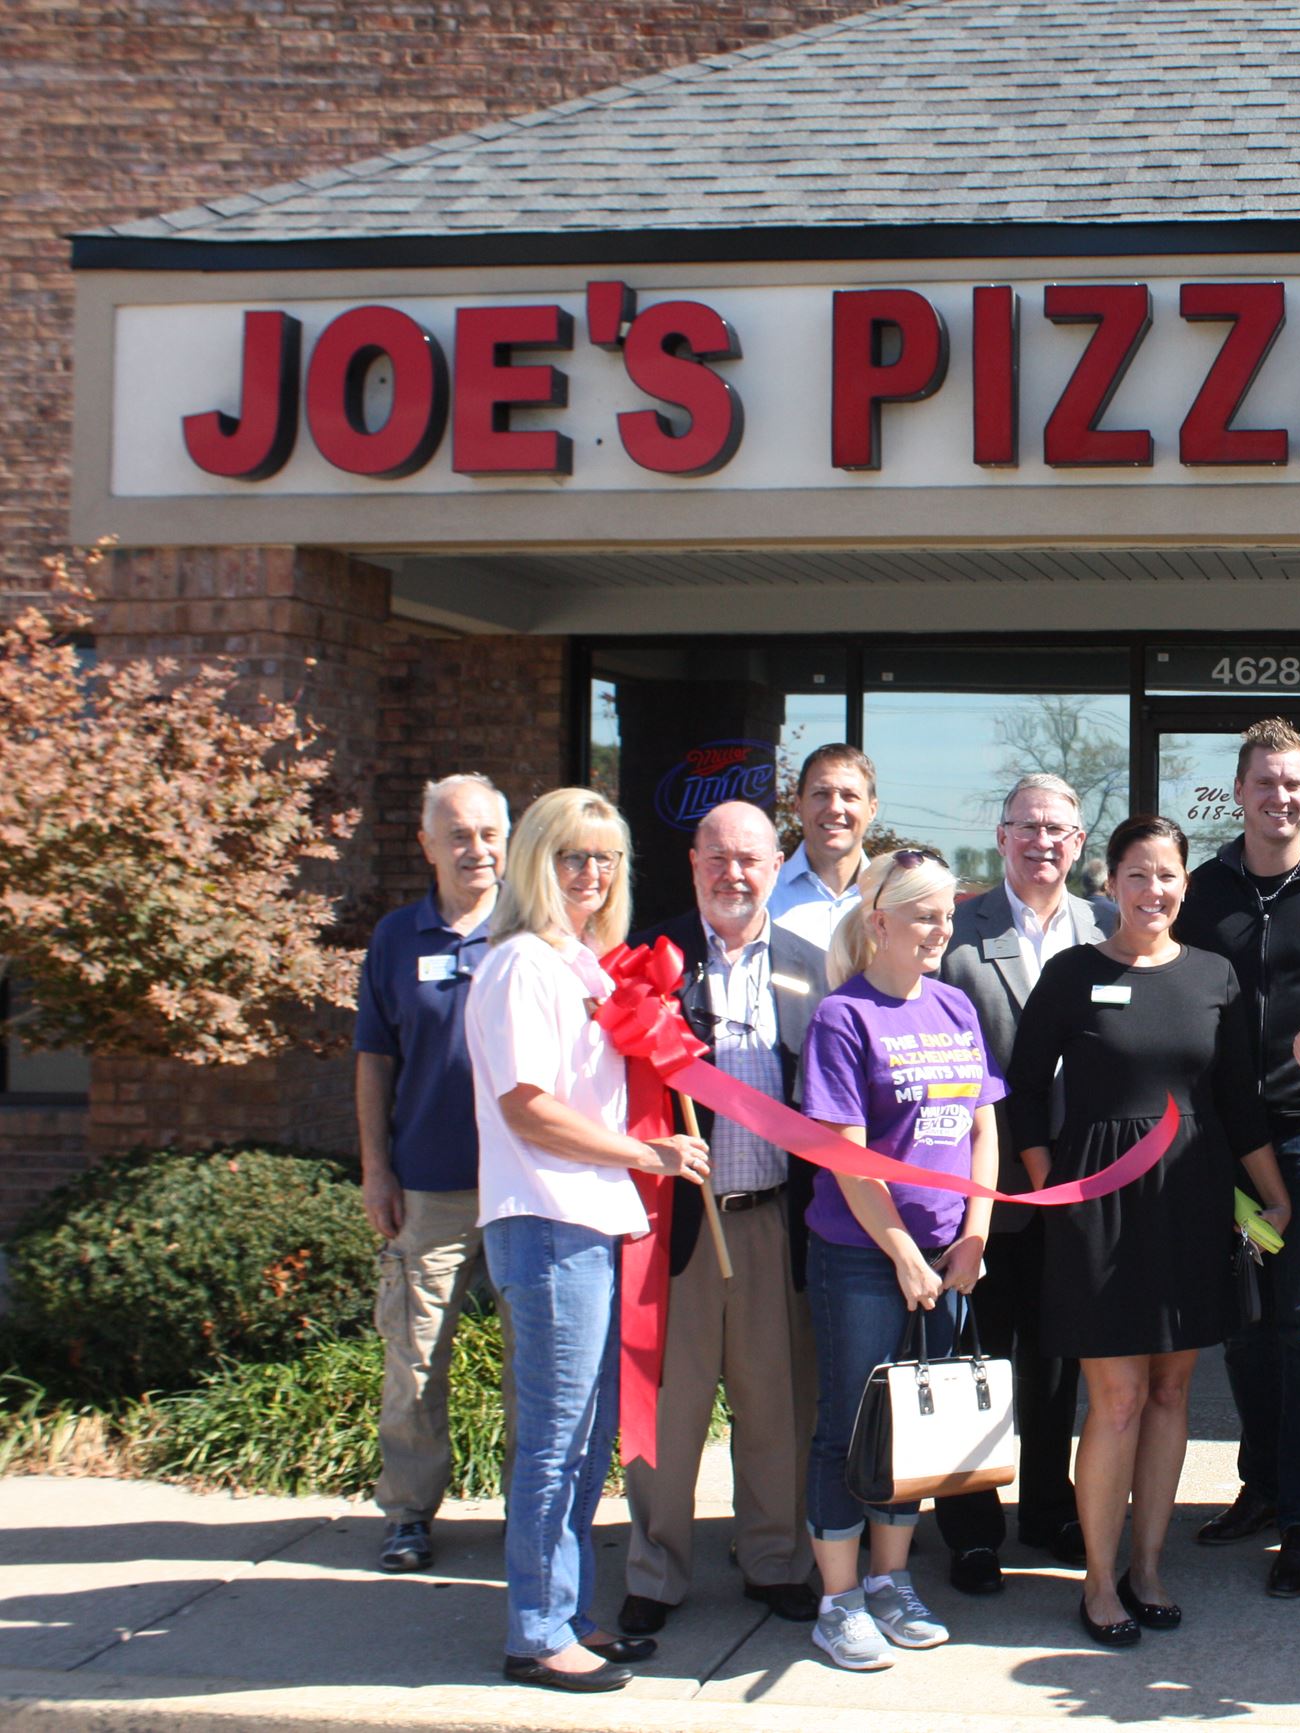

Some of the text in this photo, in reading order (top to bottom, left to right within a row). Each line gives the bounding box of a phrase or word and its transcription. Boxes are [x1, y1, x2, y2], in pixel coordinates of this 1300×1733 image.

[183, 281, 744, 481] JOE'S
[1211, 656, 1300, 686] 4628
[1194, 786, 1231, 802] We
[879, 1030, 974, 1052] THE END OF
[891, 1065, 954, 1086] STARTS
[894, 1085, 924, 1104] ME
[918, 1117, 958, 1132] END
